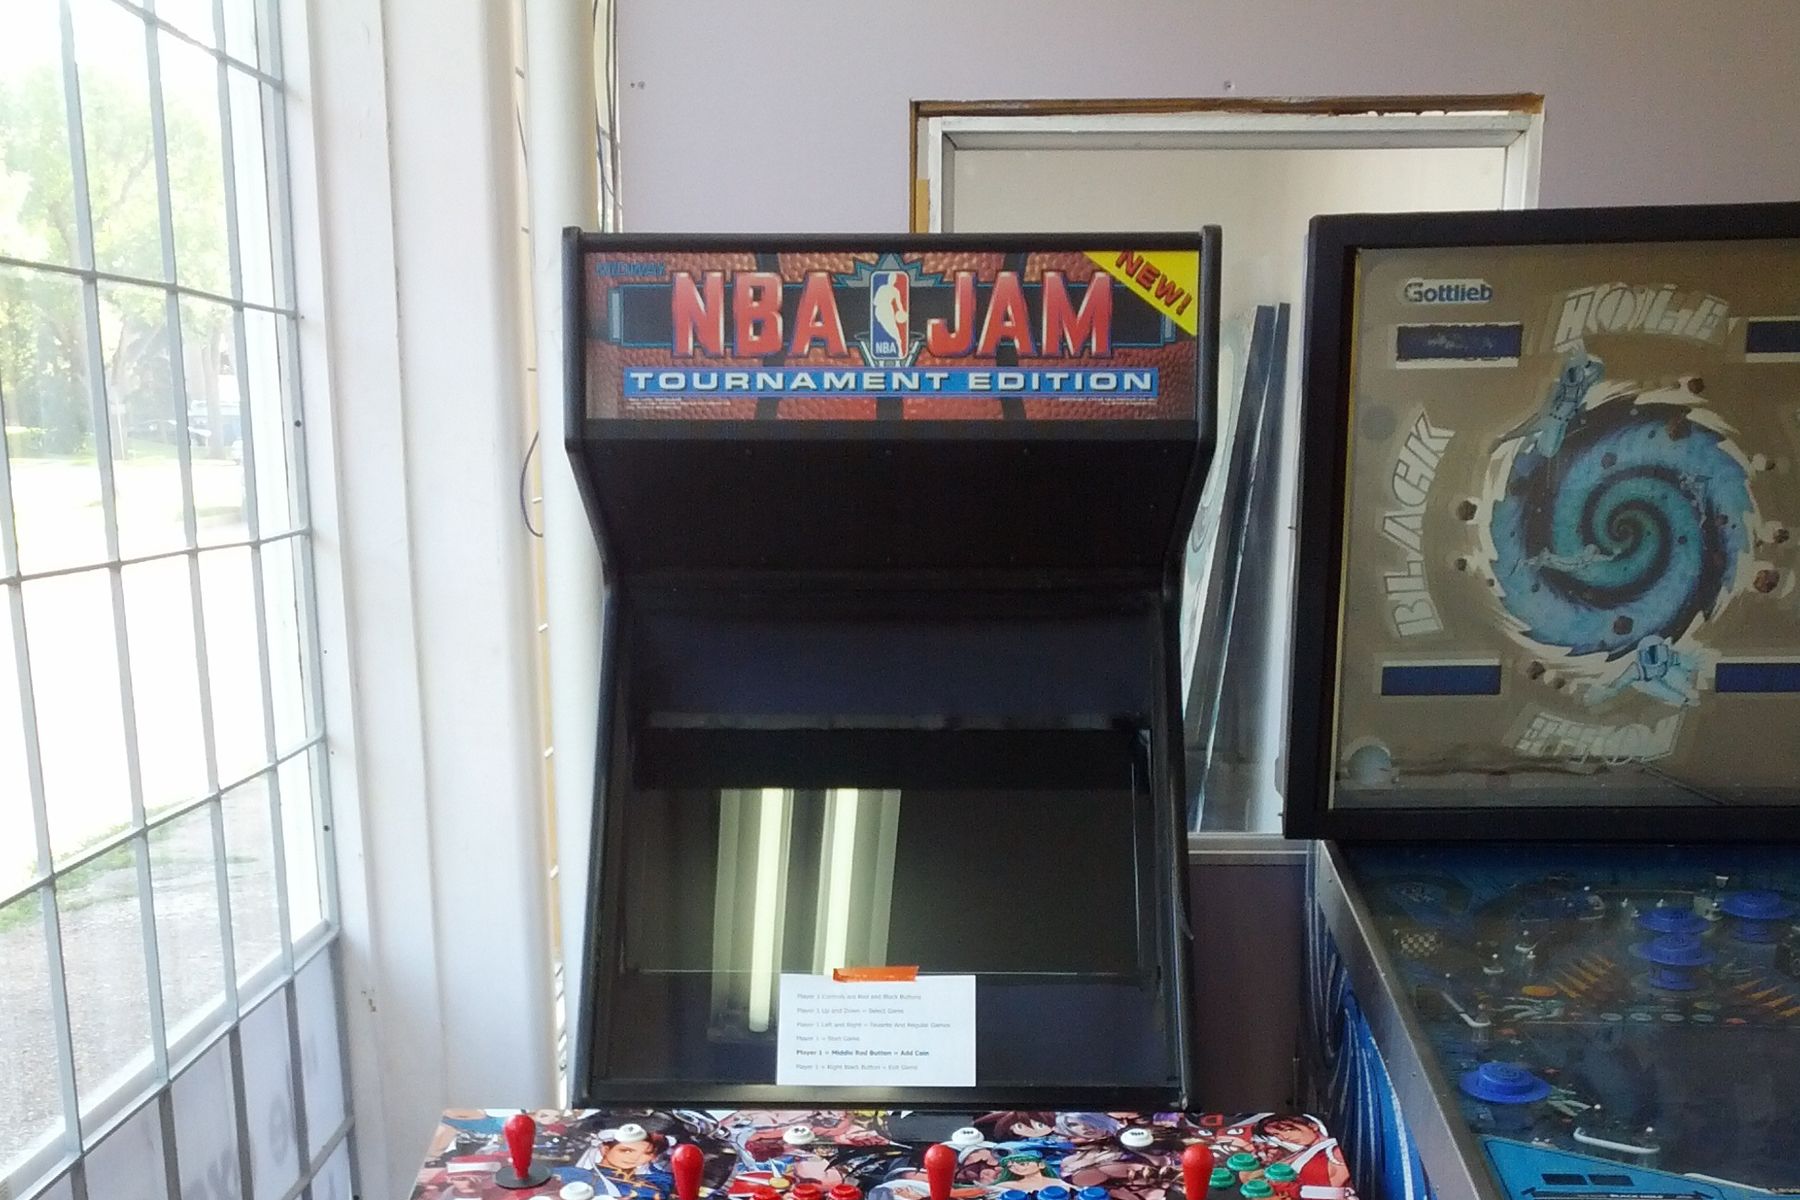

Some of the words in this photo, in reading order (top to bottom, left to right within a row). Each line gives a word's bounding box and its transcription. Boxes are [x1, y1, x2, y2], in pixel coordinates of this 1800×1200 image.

[1114, 250, 1193, 317] NEW!
[1404, 282, 1494, 302] Gottlieb
[671, 269, 850, 359] NBA
[926, 269, 1113, 359] JAM
[875, 341, 897, 355] NBA
[629, 371, 951, 392] TOURNAMENT
[968, 371, 1151, 392] EDITION
[1381, 410, 1456, 637] BLACK
